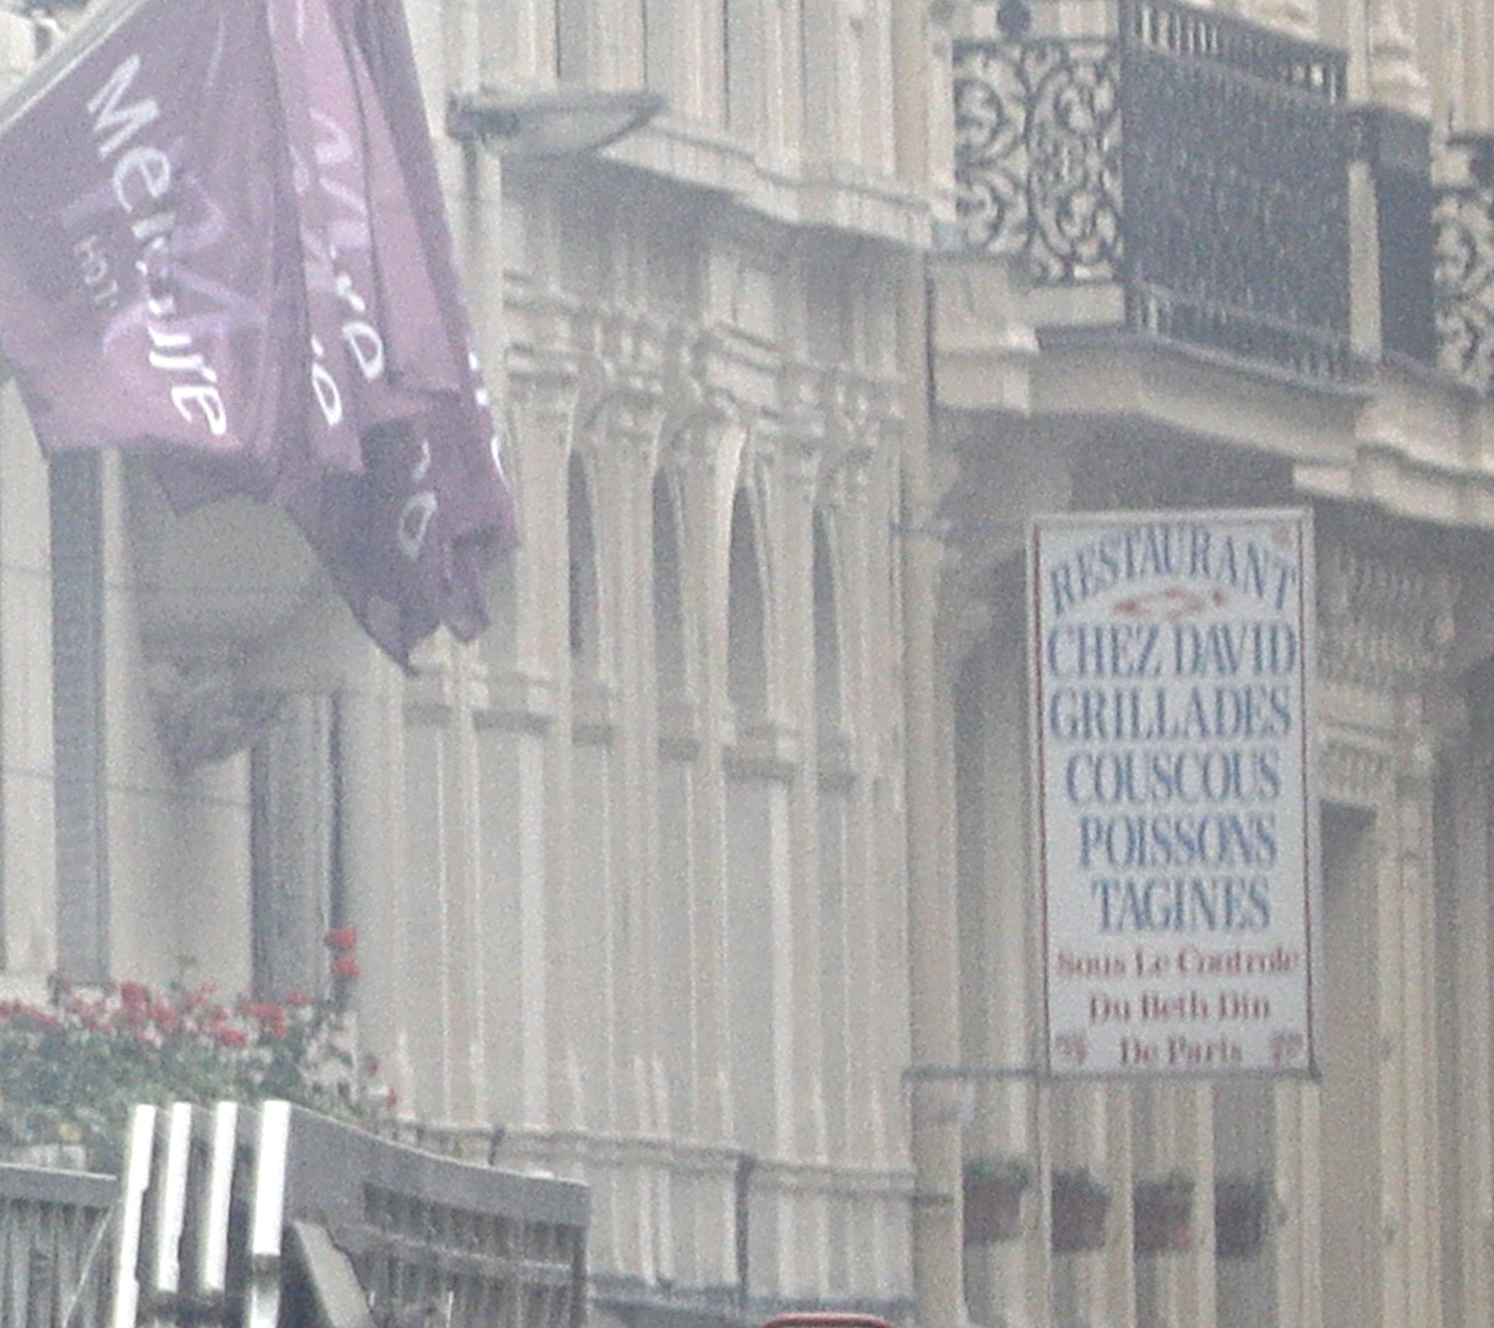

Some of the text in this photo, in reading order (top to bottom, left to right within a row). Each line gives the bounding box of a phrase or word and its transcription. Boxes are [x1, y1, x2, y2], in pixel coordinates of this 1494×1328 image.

[88, 54, 227, 436] Merure
[1050, 523, 1297, 616] RESTAURANT
[1047, 624, 1298, 677] CHEZ DAVID
[1049, 685, 1294, 741] GRILLADES
[1066, 750, 1282, 805] COUSCOUS
[1079, 814, 1278, 868] POISSONS
[1091, 877, 1272, 932] TAGINES
[1134, 950, 1169, 975] Le
[1089, 993, 1132, 1022] Du
[1120, 1035, 1243, 1066] De Paris
